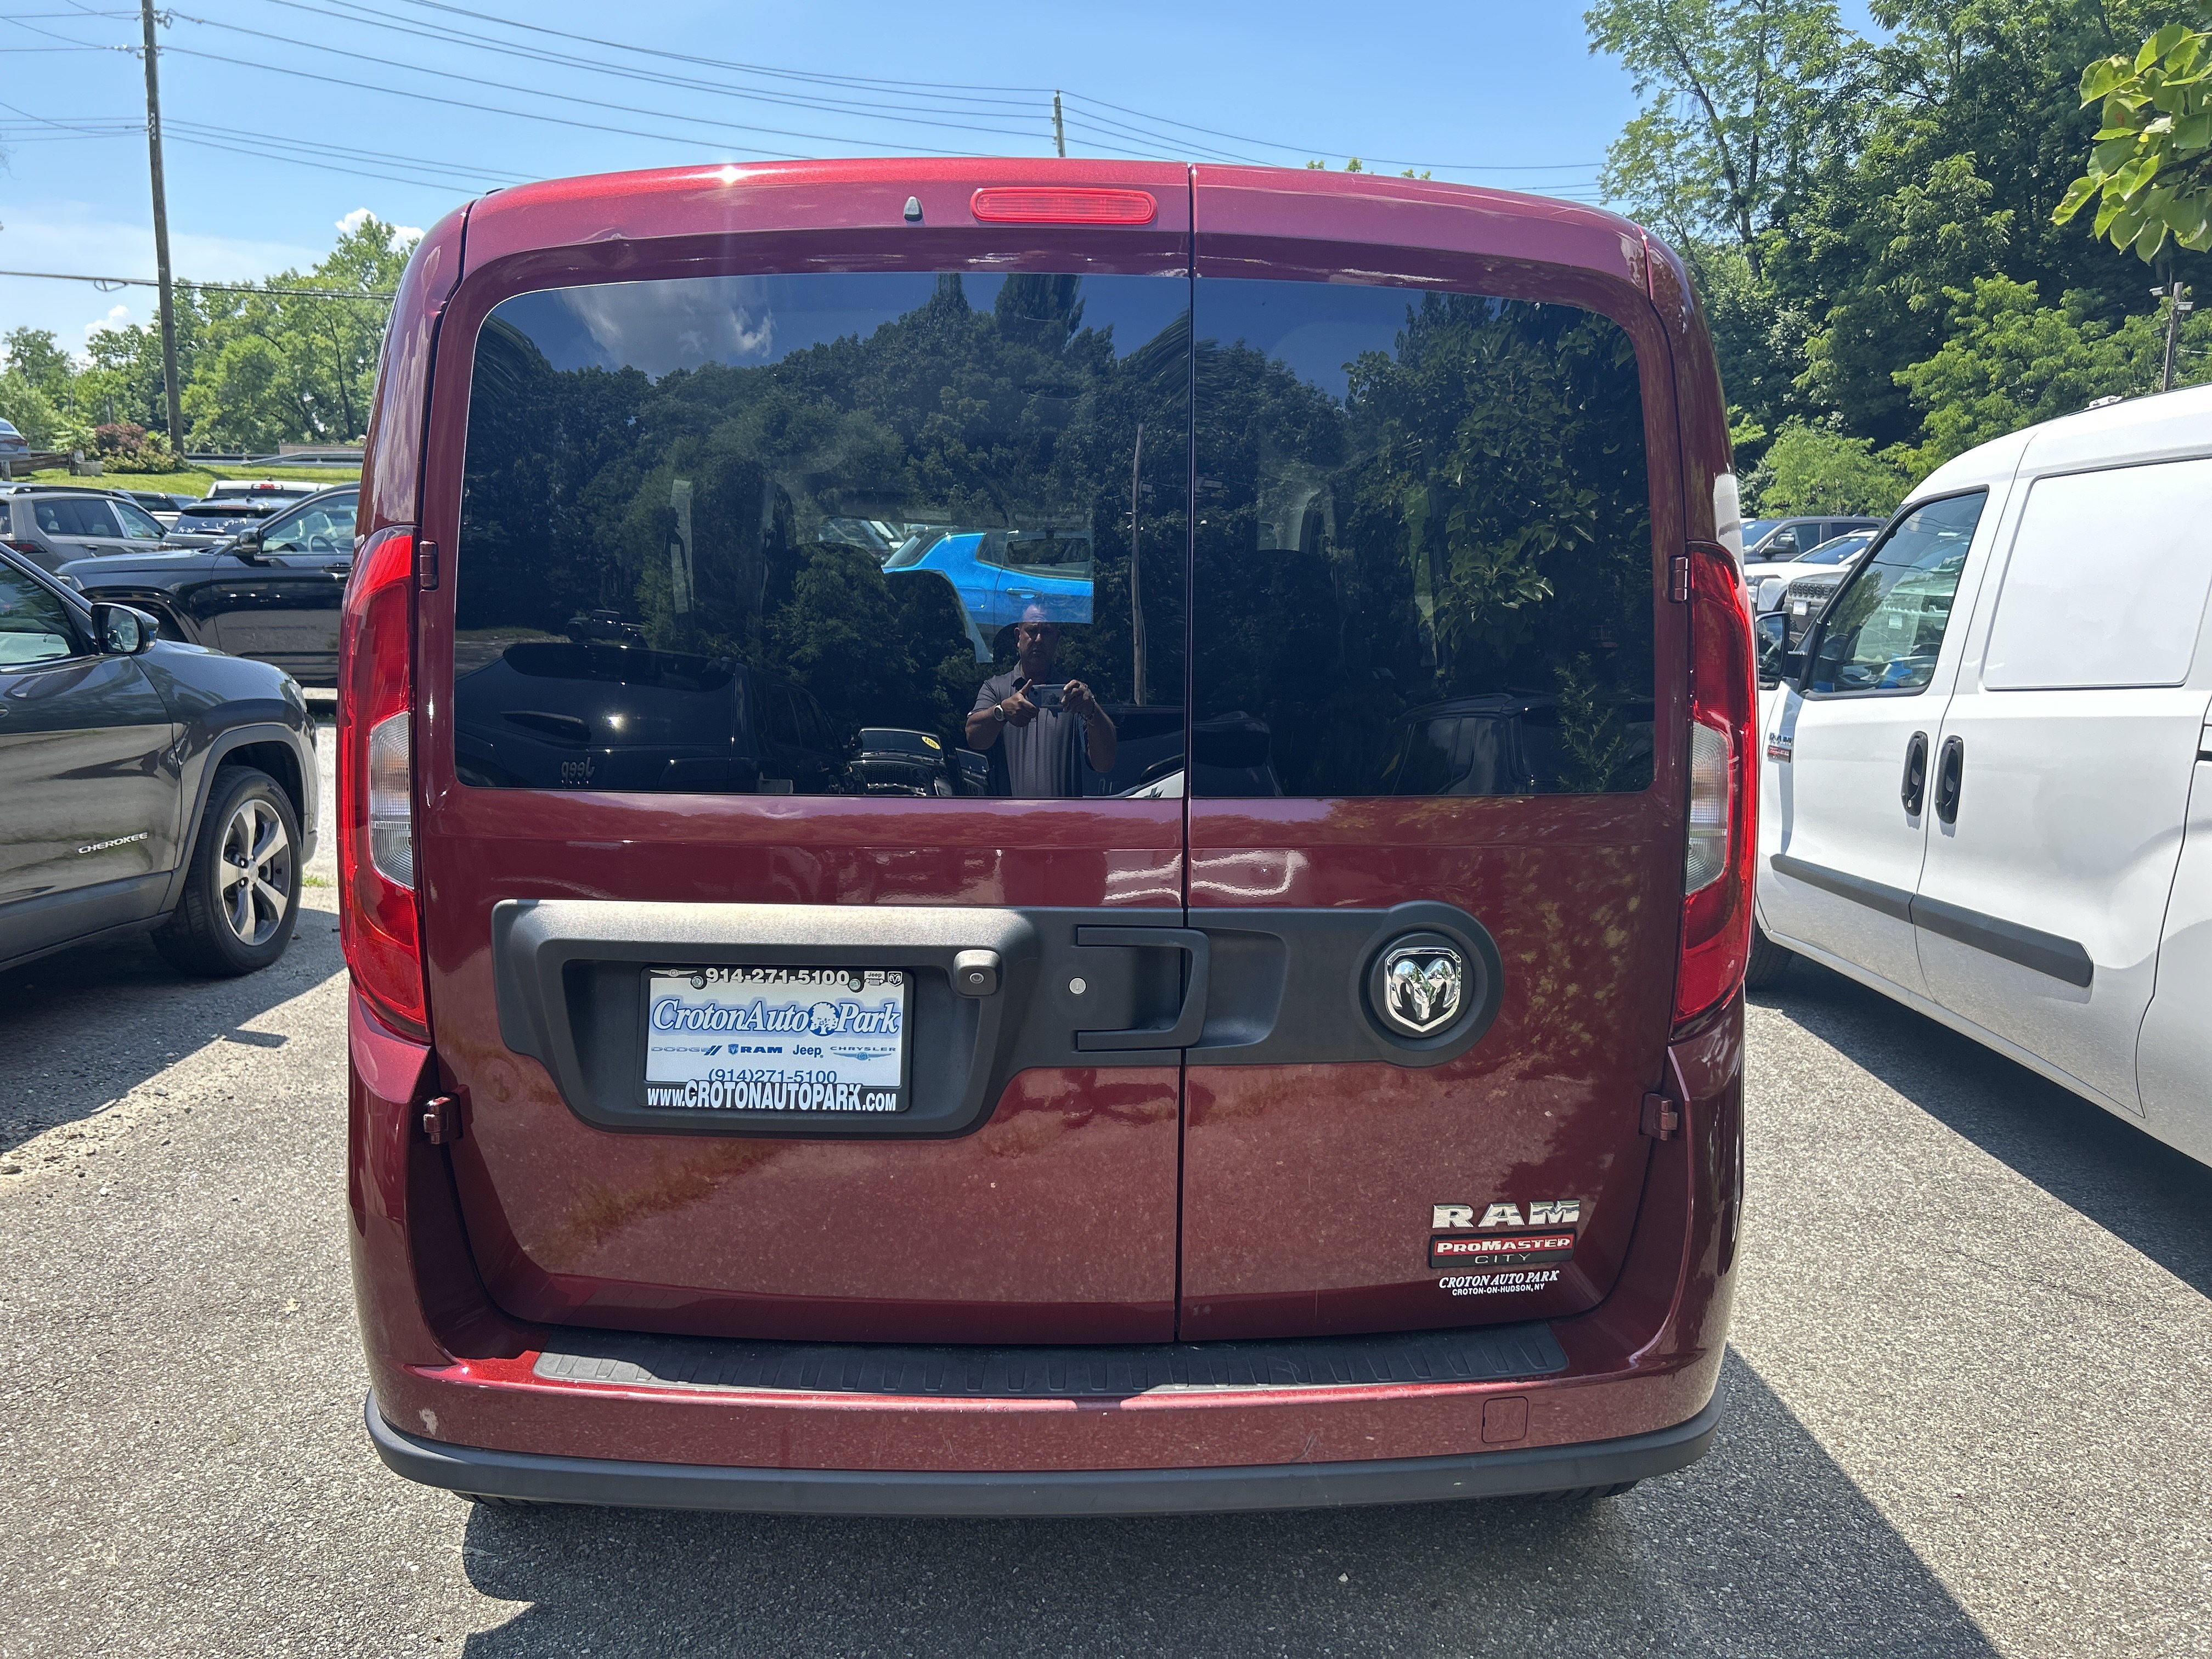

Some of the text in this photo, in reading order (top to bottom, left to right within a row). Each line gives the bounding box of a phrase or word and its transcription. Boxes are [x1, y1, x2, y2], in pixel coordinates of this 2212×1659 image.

[78, 832, 148, 854] CHEROKEE
[706, 968, 850, 985] 914-271-5100
[833, 1001, 901, 1034] Park
[793, 1045, 822, 1058] Jeep
[708, 1069, 837, 1084] (914)271-5100
[1432, 1199, 1581, 1228] RAM
[1474, 1253, 1531, 1264] CITY
[1439, 1270, 1560, 1289] CROTON AUTO PARK
[1452, 1285, 1533, 1296] CROTON-ON-HUDSON,
